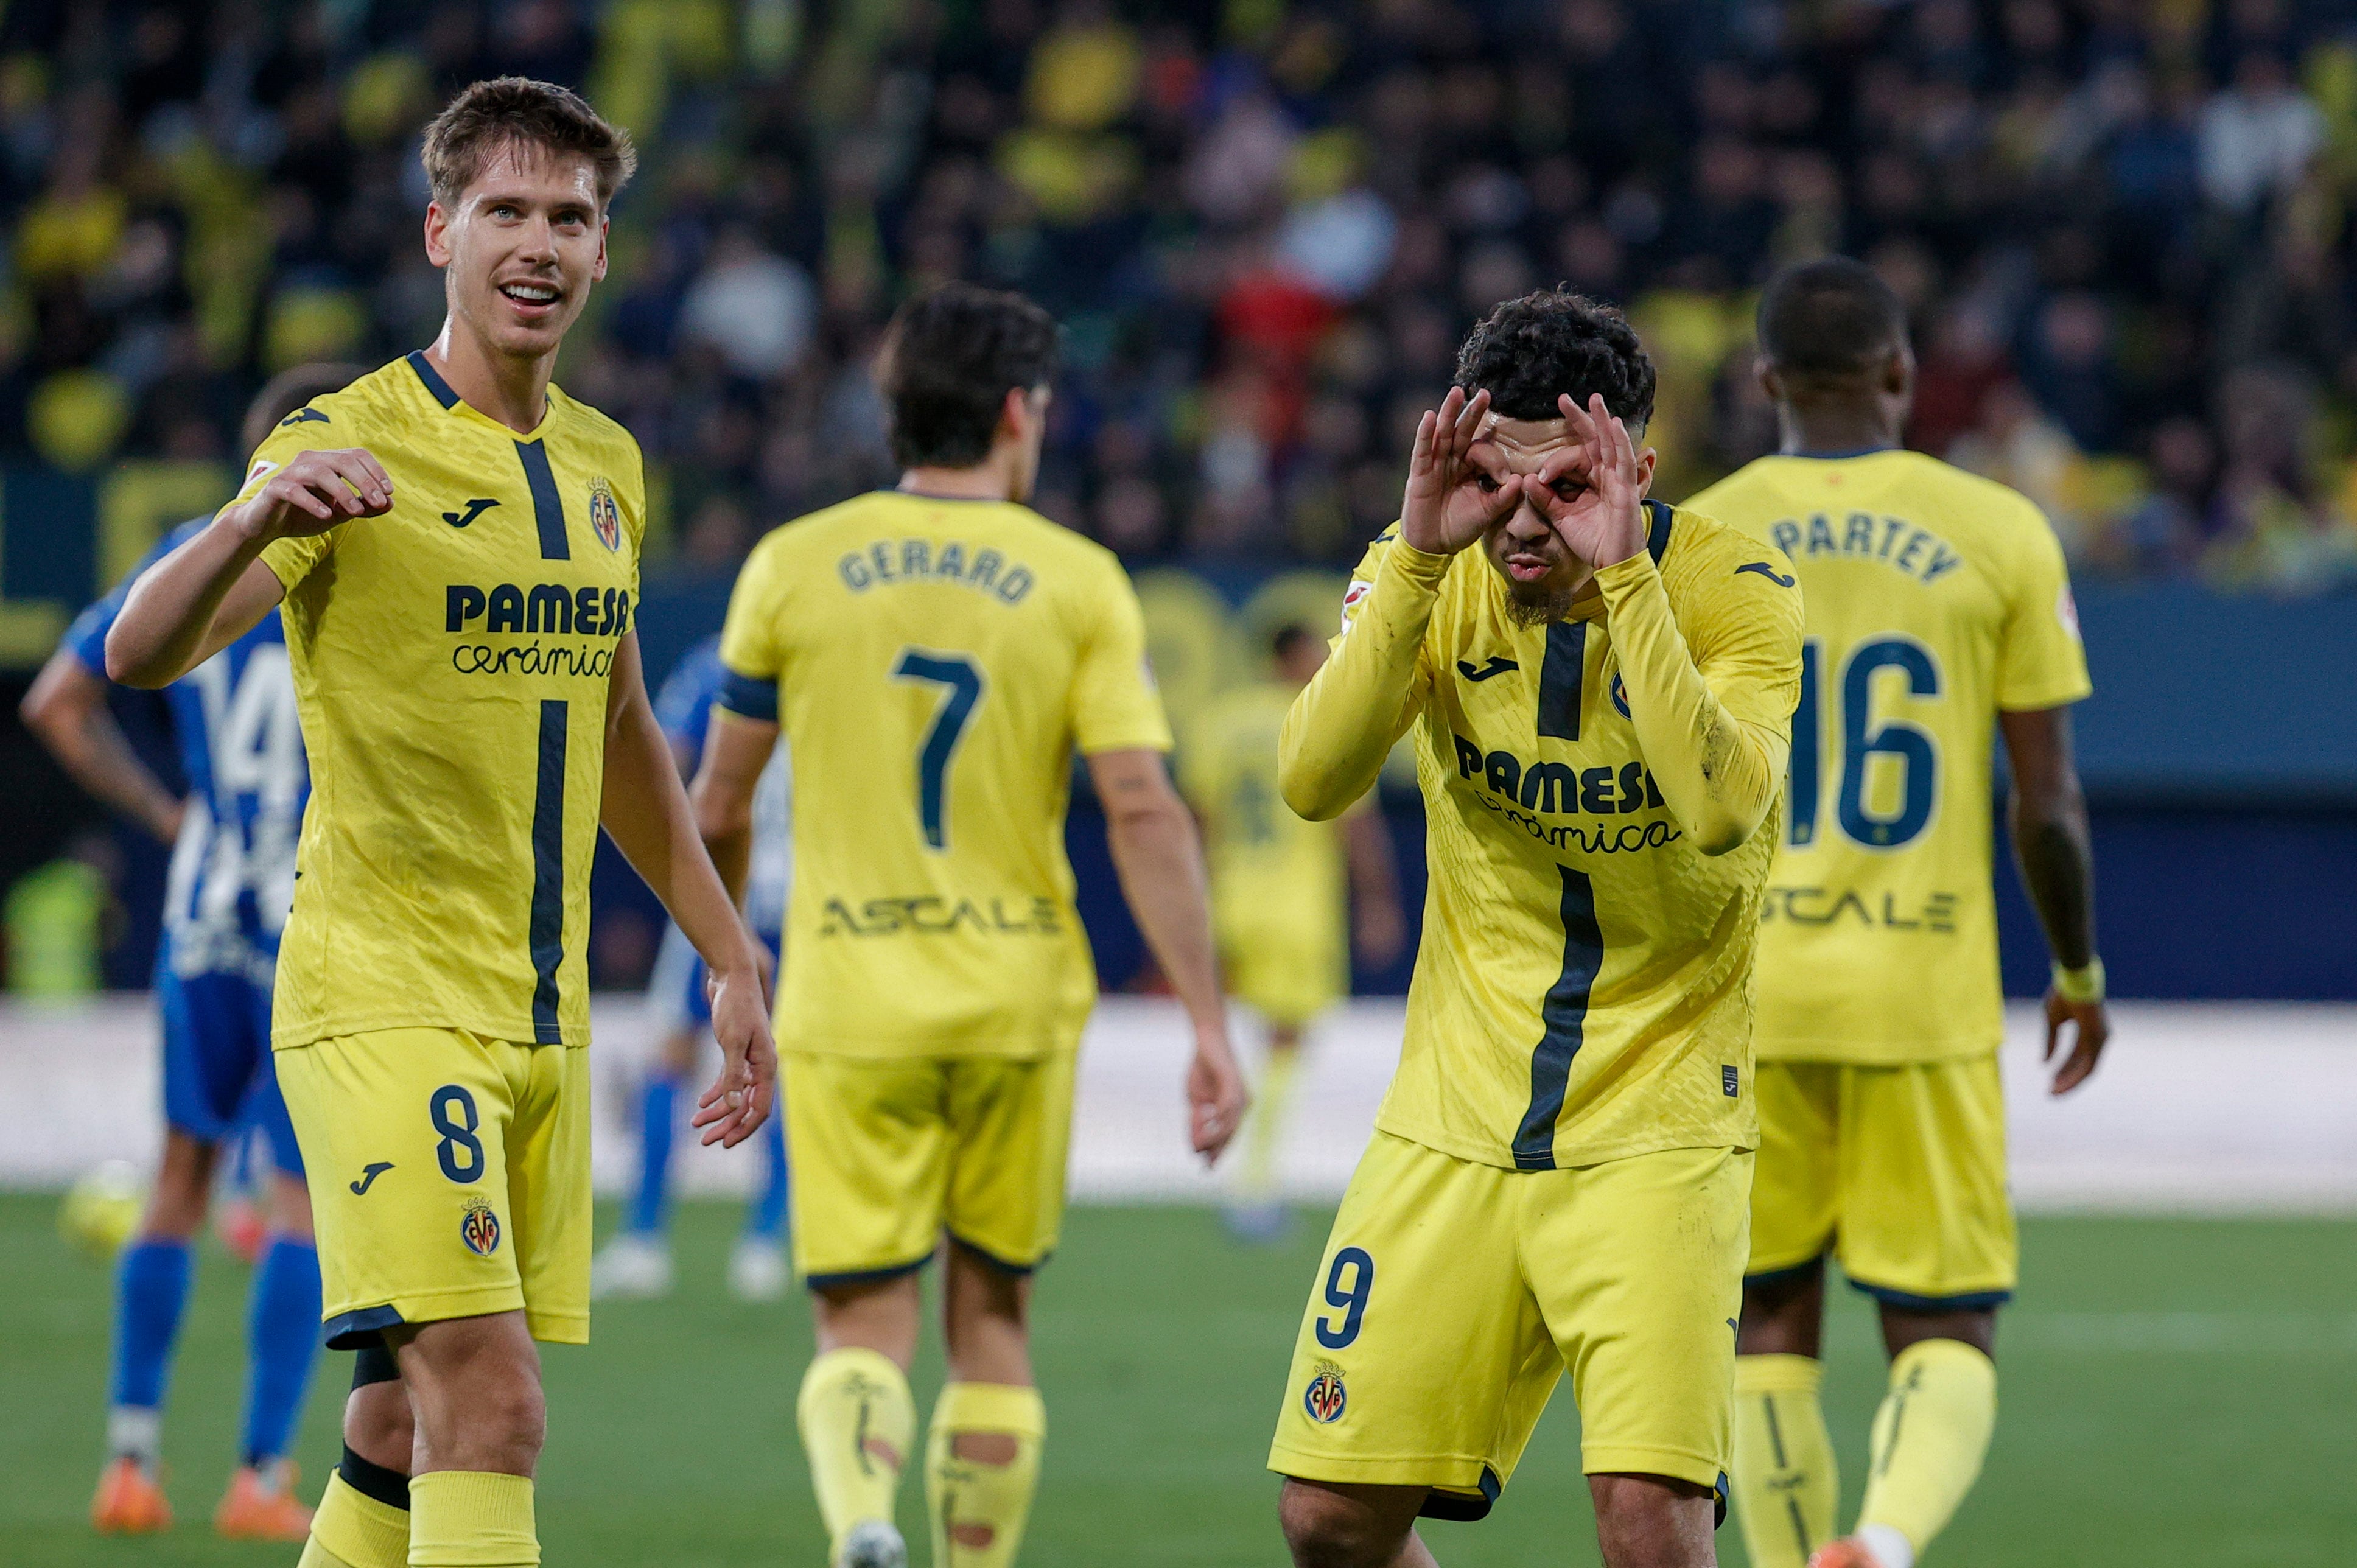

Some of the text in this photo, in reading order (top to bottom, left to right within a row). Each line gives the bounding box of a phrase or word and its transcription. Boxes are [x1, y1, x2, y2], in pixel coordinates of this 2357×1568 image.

[838, 540, 1034, 605] GERARD
[1771, 514, 1961, 583] PARTEY
[446, 584, 629, 637] PAMESA
[183, 640, 306, 813] 14
[894, 649, 982, 849] 7
[1786, 639, 1937, 846] 16
[429, 1083, 485, 1184] 8
[1315, 1246, 1375, 1349] 9
